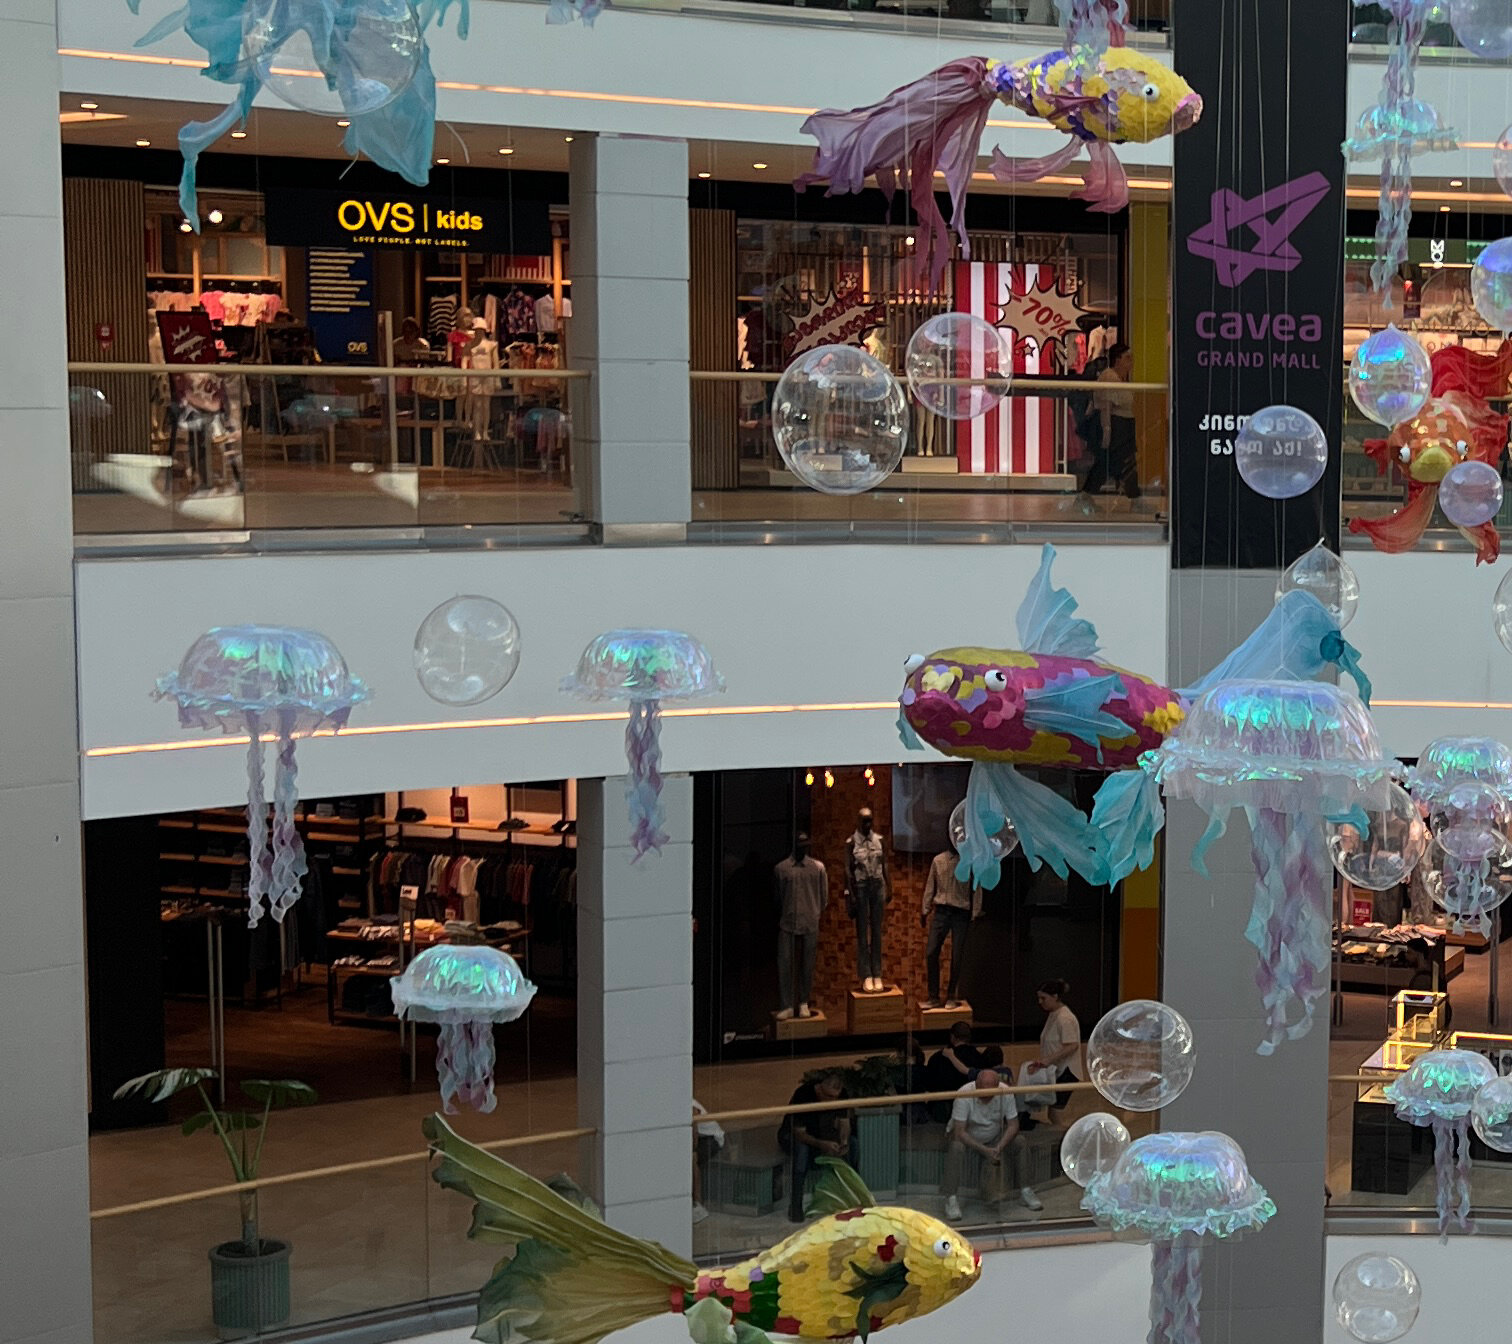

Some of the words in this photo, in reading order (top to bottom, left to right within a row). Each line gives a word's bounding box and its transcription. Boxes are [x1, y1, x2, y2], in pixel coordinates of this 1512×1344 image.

[337, 199, 416, 233] OVS
[436, 209, 484, 231] kids
[1195, 311, 1322, 342] cavea
[1197, 350, 1264, 368] GRAND
[1272, 352, 1321, 369] MALL
